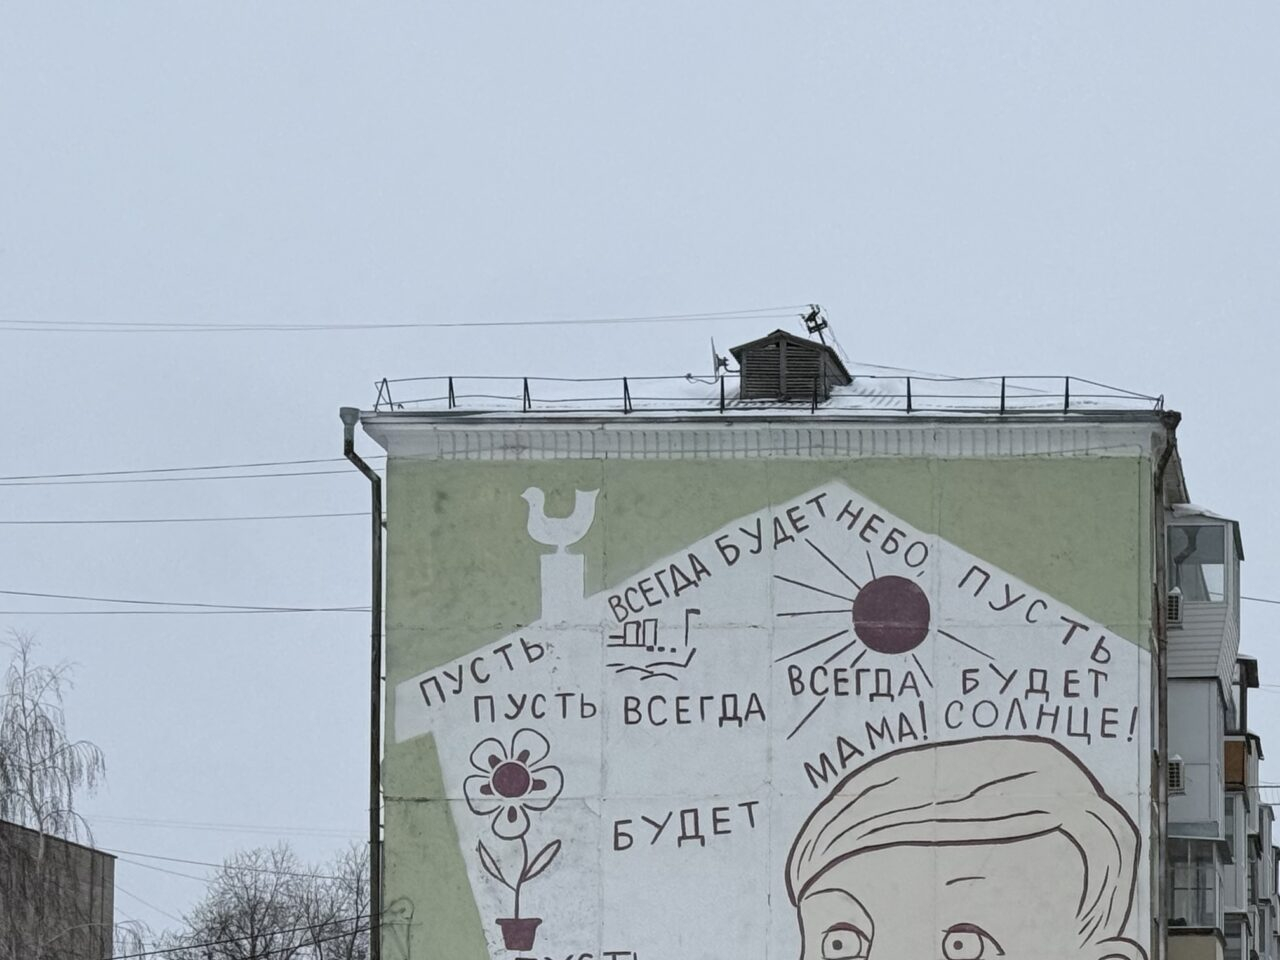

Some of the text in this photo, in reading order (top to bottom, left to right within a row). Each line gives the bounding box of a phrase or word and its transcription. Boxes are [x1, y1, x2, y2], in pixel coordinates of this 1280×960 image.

[420, 638, 545, 706] ПУСТЬ
[608, 553, 711, 622] ВСЕГДА
[715, 493, 827, 566] БУДЕТ
[958, 566, 1111, 665] ПУСТЬ
[788, 663, 1108, 702] ВСЕГДА БУДЕТ
[474, 693, 766, 728] ПУСТЬ ВСЕГДА
[945, 699, 1138, 743] СОЛНЦЕ!
[804, 701, 928, 788] МАМА!
[614, 801, 759, 851] БУДЕТ
